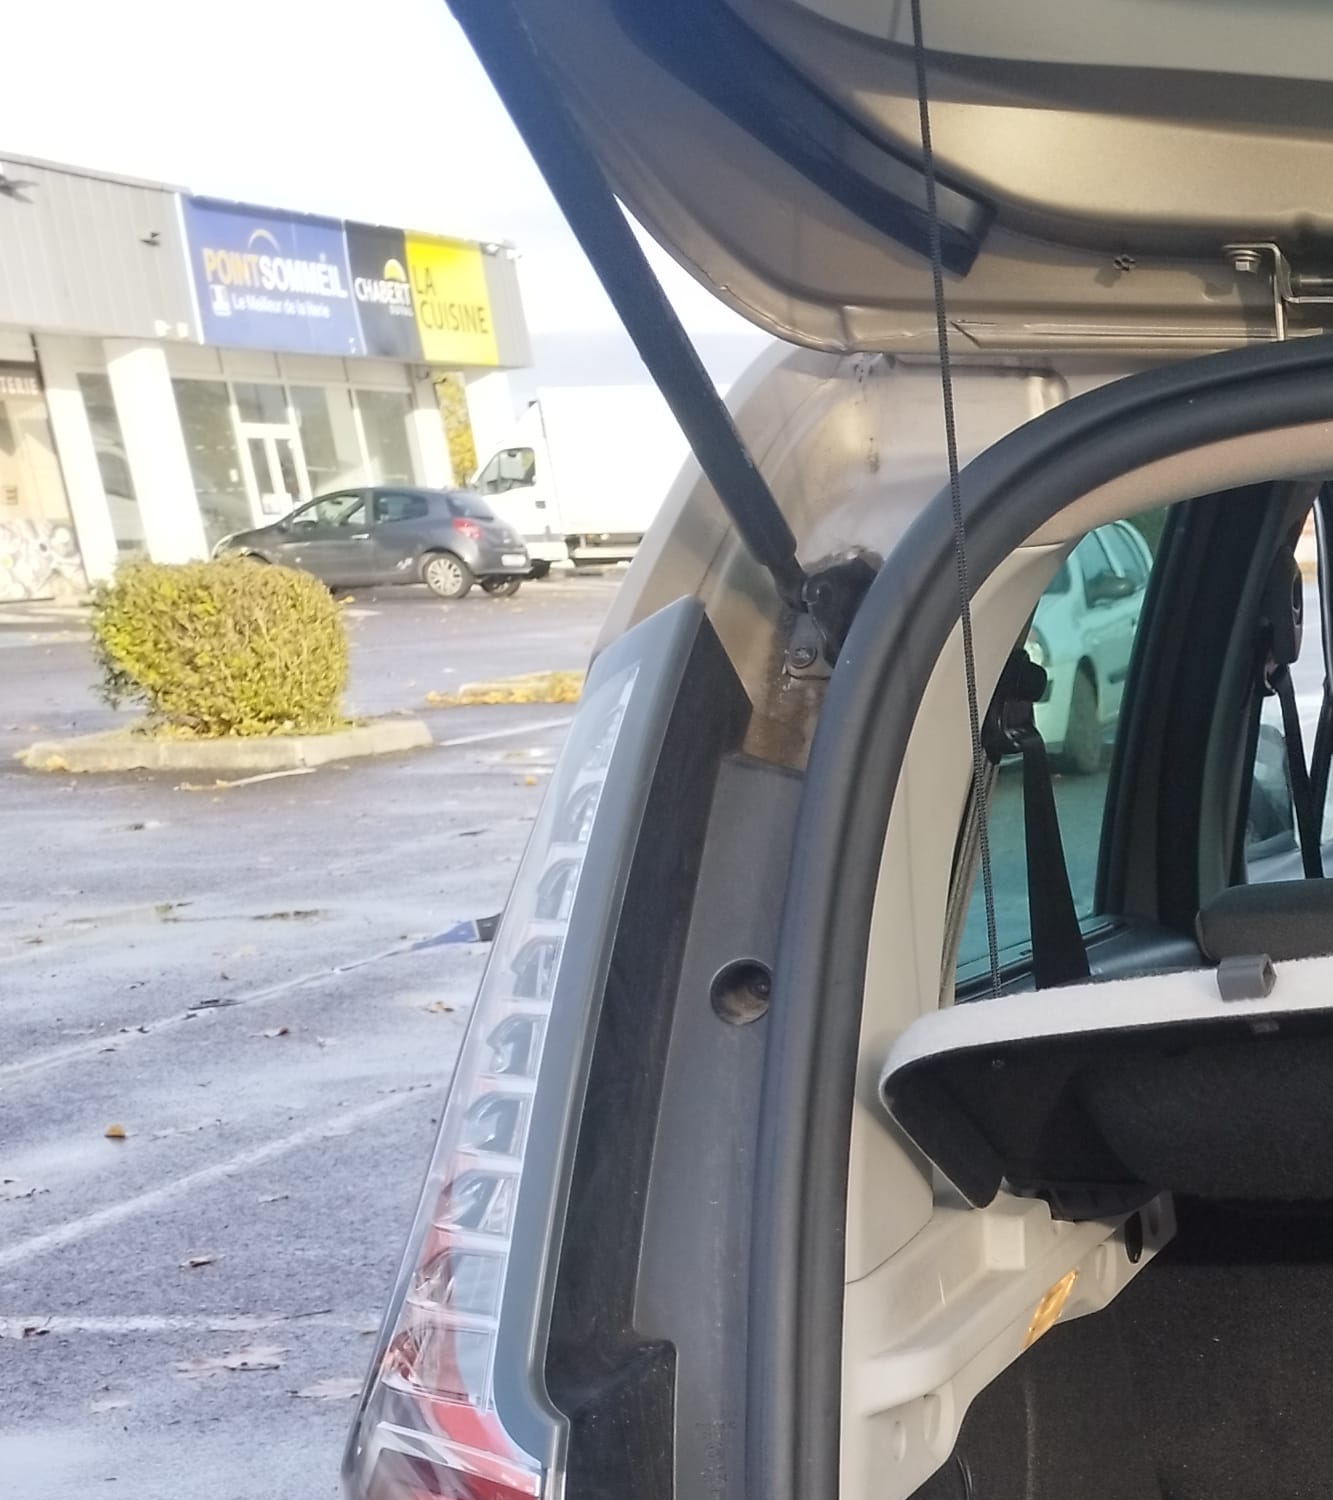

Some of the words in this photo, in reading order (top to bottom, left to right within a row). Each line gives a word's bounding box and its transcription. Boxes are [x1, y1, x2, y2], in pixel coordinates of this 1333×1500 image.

[355, 277, 411, 306] CHABERT
[412, 264, 436, 296] LA
[420, 300, 489, 334] CUISINE
